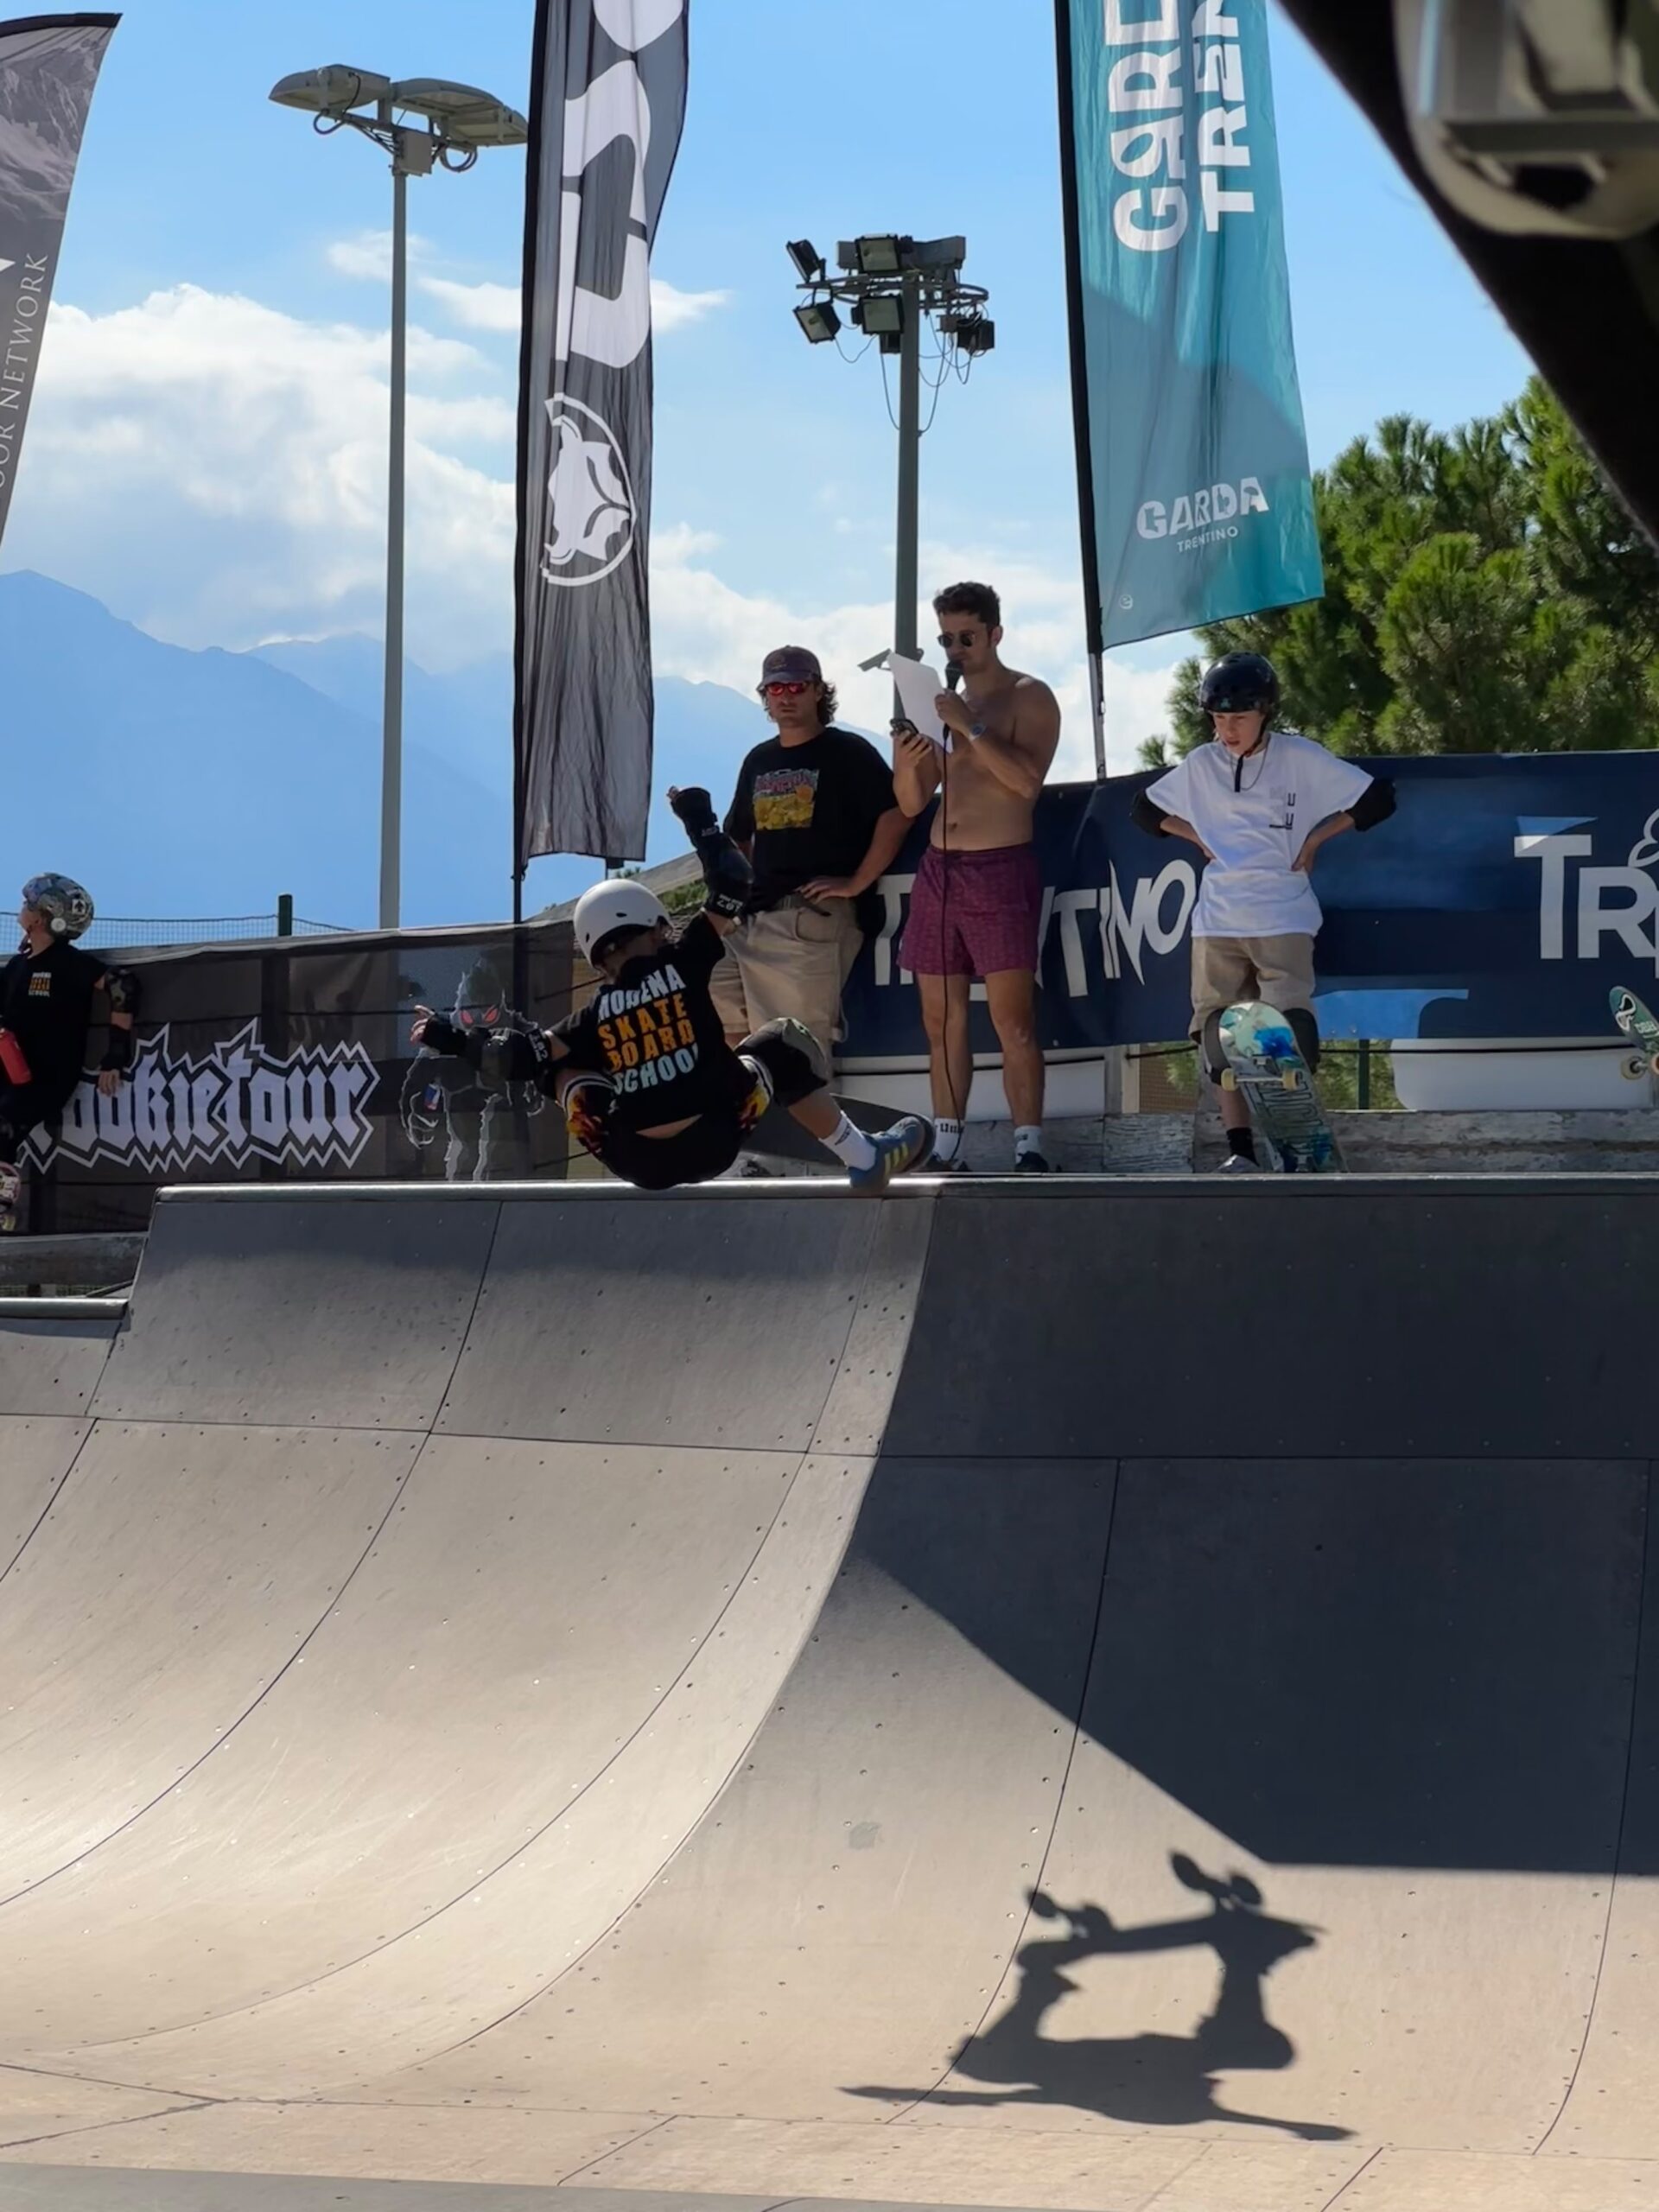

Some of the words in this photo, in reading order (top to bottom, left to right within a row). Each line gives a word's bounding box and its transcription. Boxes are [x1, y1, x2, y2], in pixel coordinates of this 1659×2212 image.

[0, 252, 48, 410] NETWORK
[1136, 476, 1269, 540] GARDA
[1176, 525, 1239, 553] TRENTINO
[874, 859, 1197, 1001] TTINO
[1514, 833, 1659, 979] TR
[598, 993, 687, 1050] SKATE
[607, 1018, 695, 1072] BOARD
[28, 1042, 369, 1154] ookietour
